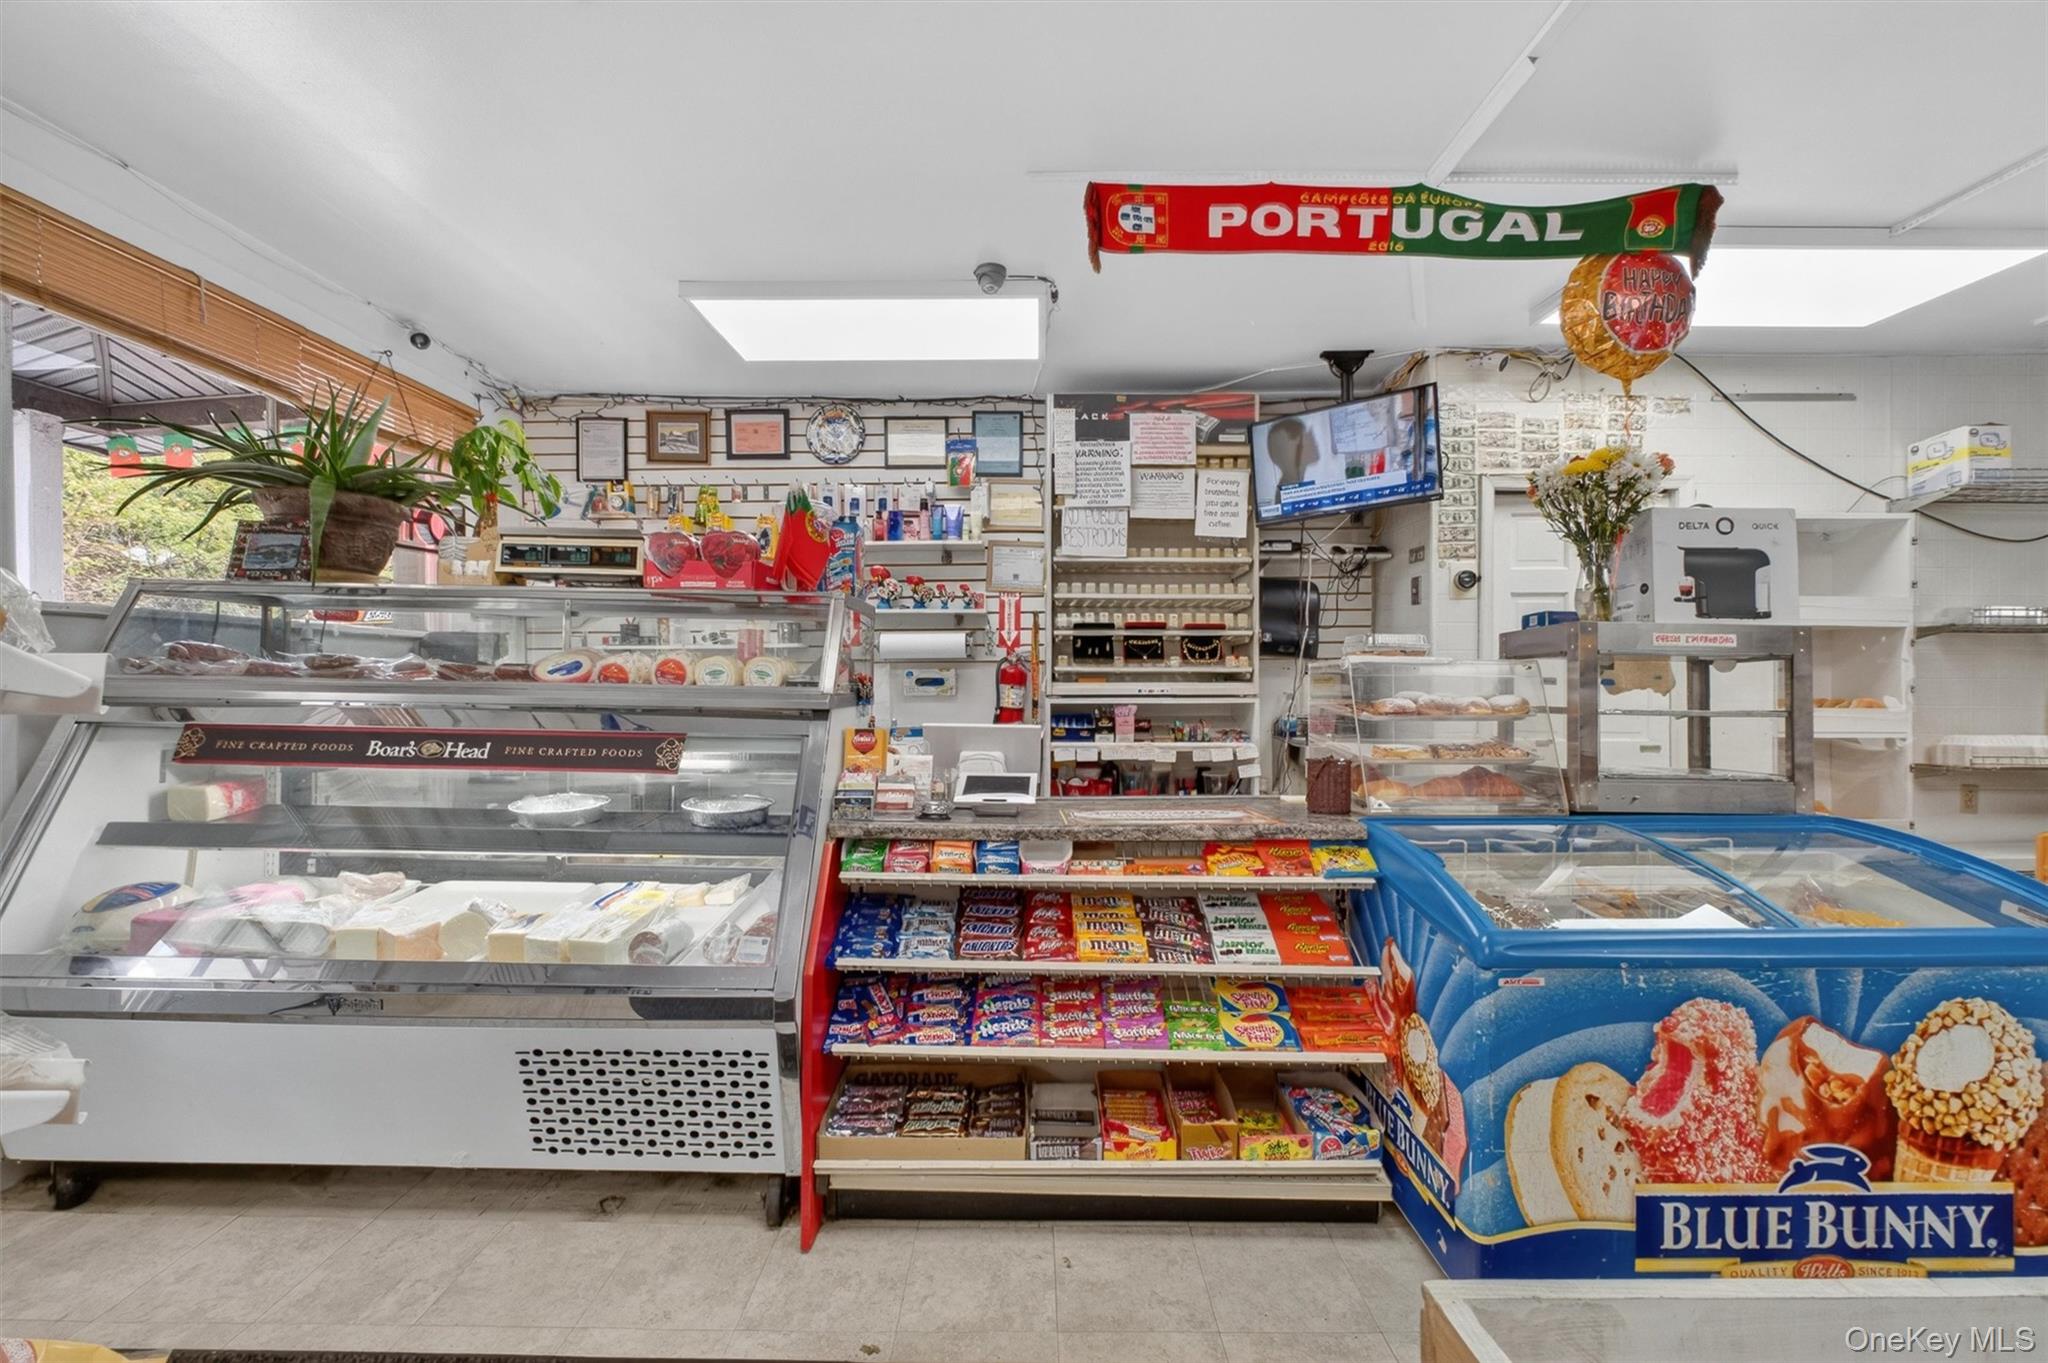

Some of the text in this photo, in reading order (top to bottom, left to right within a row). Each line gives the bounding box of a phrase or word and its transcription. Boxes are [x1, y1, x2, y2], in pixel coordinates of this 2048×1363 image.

[1208, 204, 1583, 242] PORTUGAL
[1368, 241, 1405, 251] 2016
[1602, 290, 1690, 324] BIRTHDA
[1678, 521, 1710, 531] DELTA
[1751, 522, 1779, 531] QUICK
[215, 739, 644, 760] FINE CRAFTED FOODS Boar's Head FINE CRAFTED FOODS
[1659, 1200, 1794, 1250] BLUE
[1729, 1267, 1789, 1278] QUALITY
[1799, 1262, 1847, 1278] Wells
[1858, 1266, 1893, 1277] SINCE
